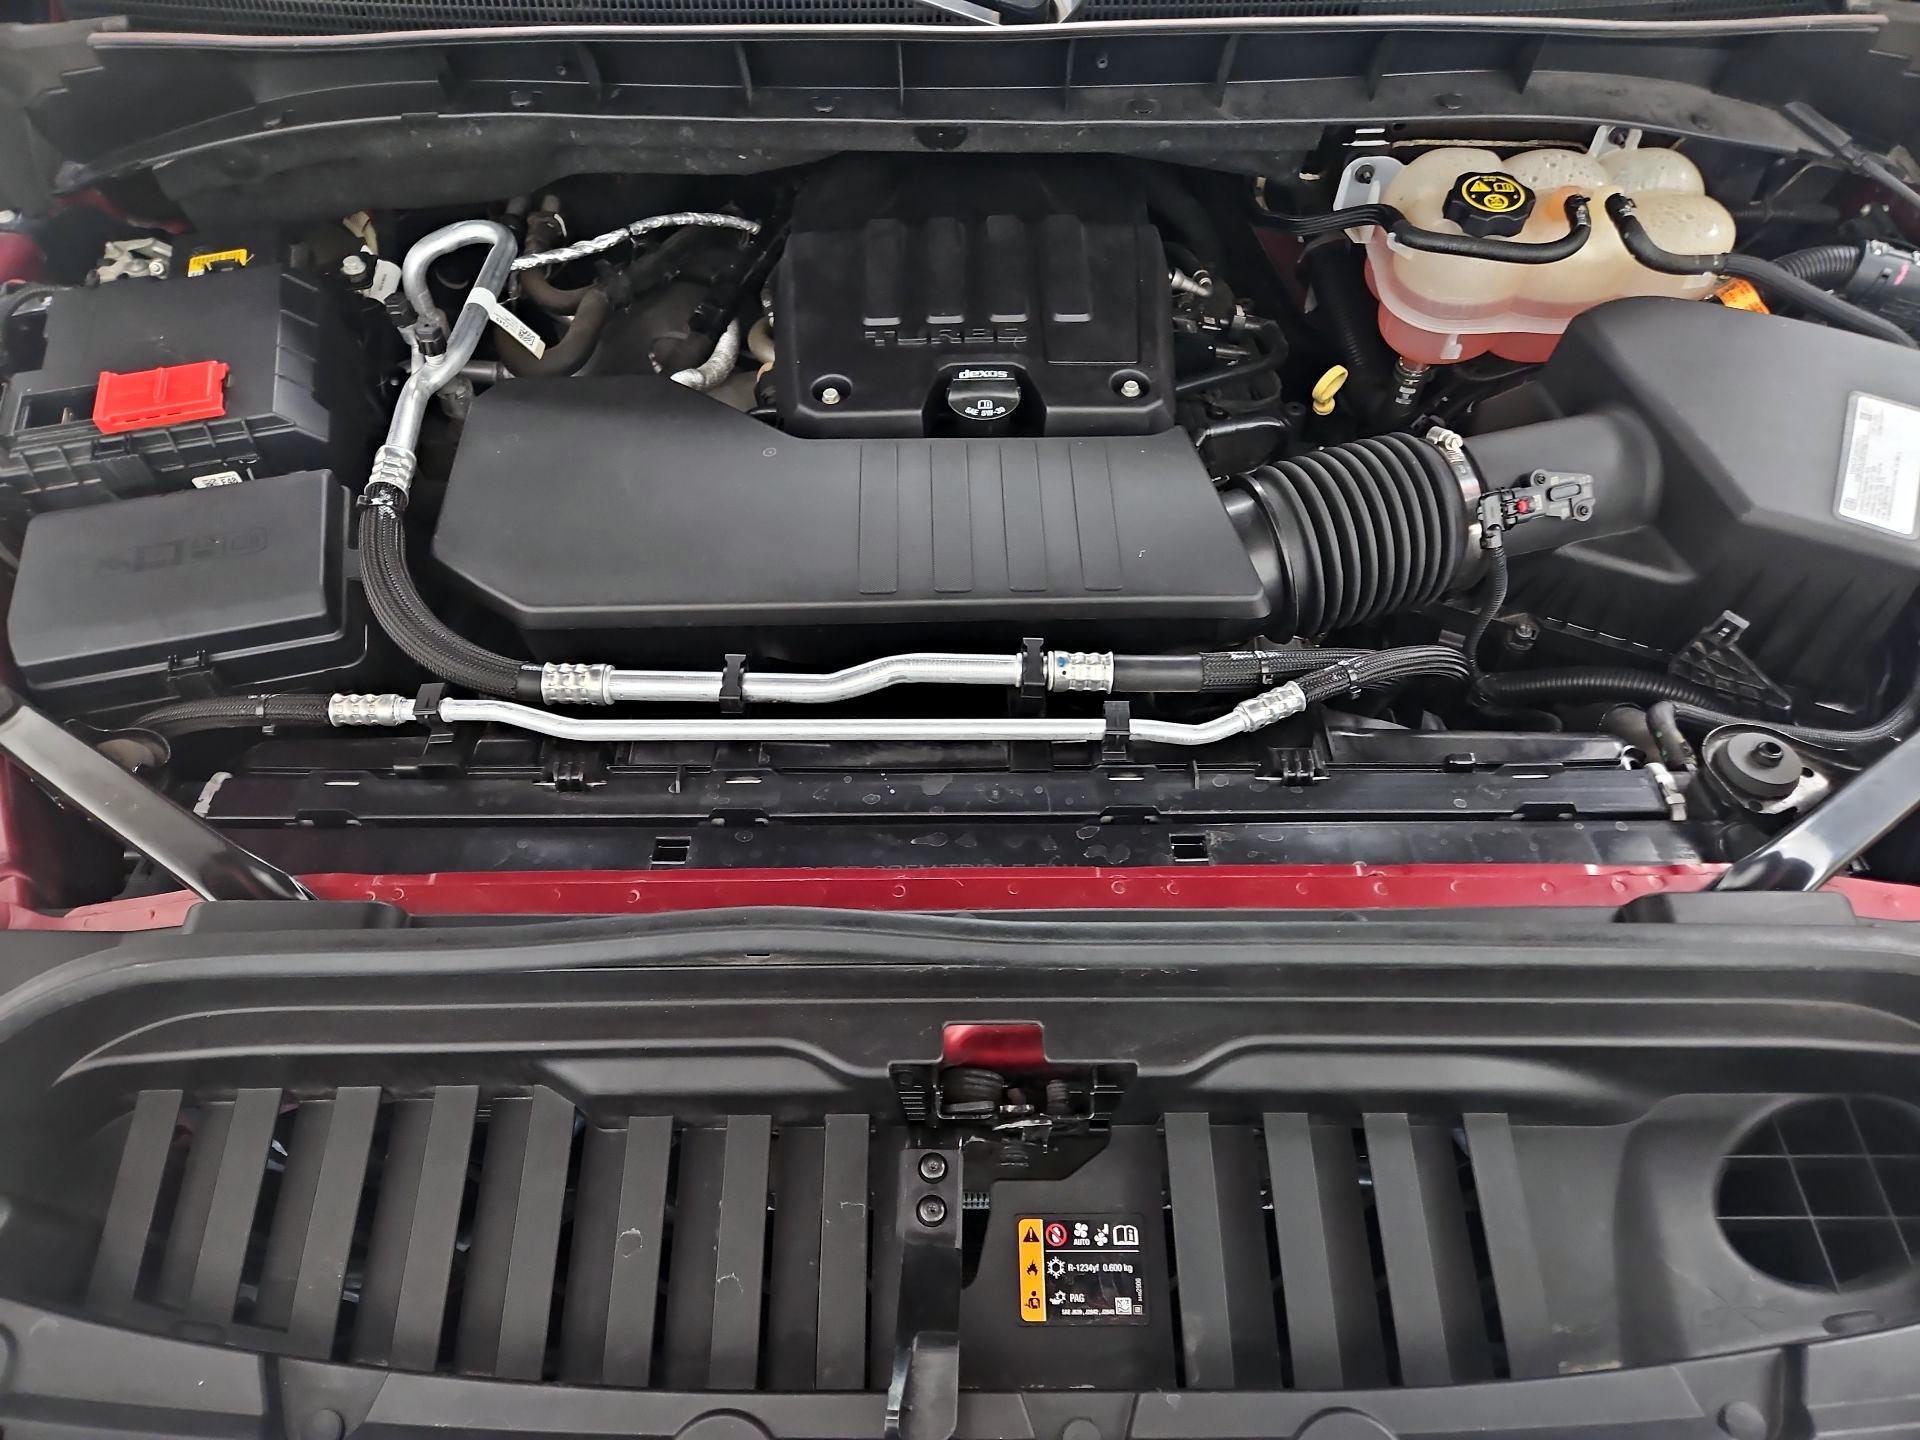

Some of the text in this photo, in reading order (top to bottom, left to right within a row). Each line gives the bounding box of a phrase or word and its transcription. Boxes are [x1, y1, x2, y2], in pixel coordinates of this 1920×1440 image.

[958, 369, 1009, 379] dexos
[1073, 1238, 1091, 1246] AUTO
[1067, 1263, 1134, 1274] R-1234yf 0.600 kg
[1069, 1293, 1086, 1303] PAG
